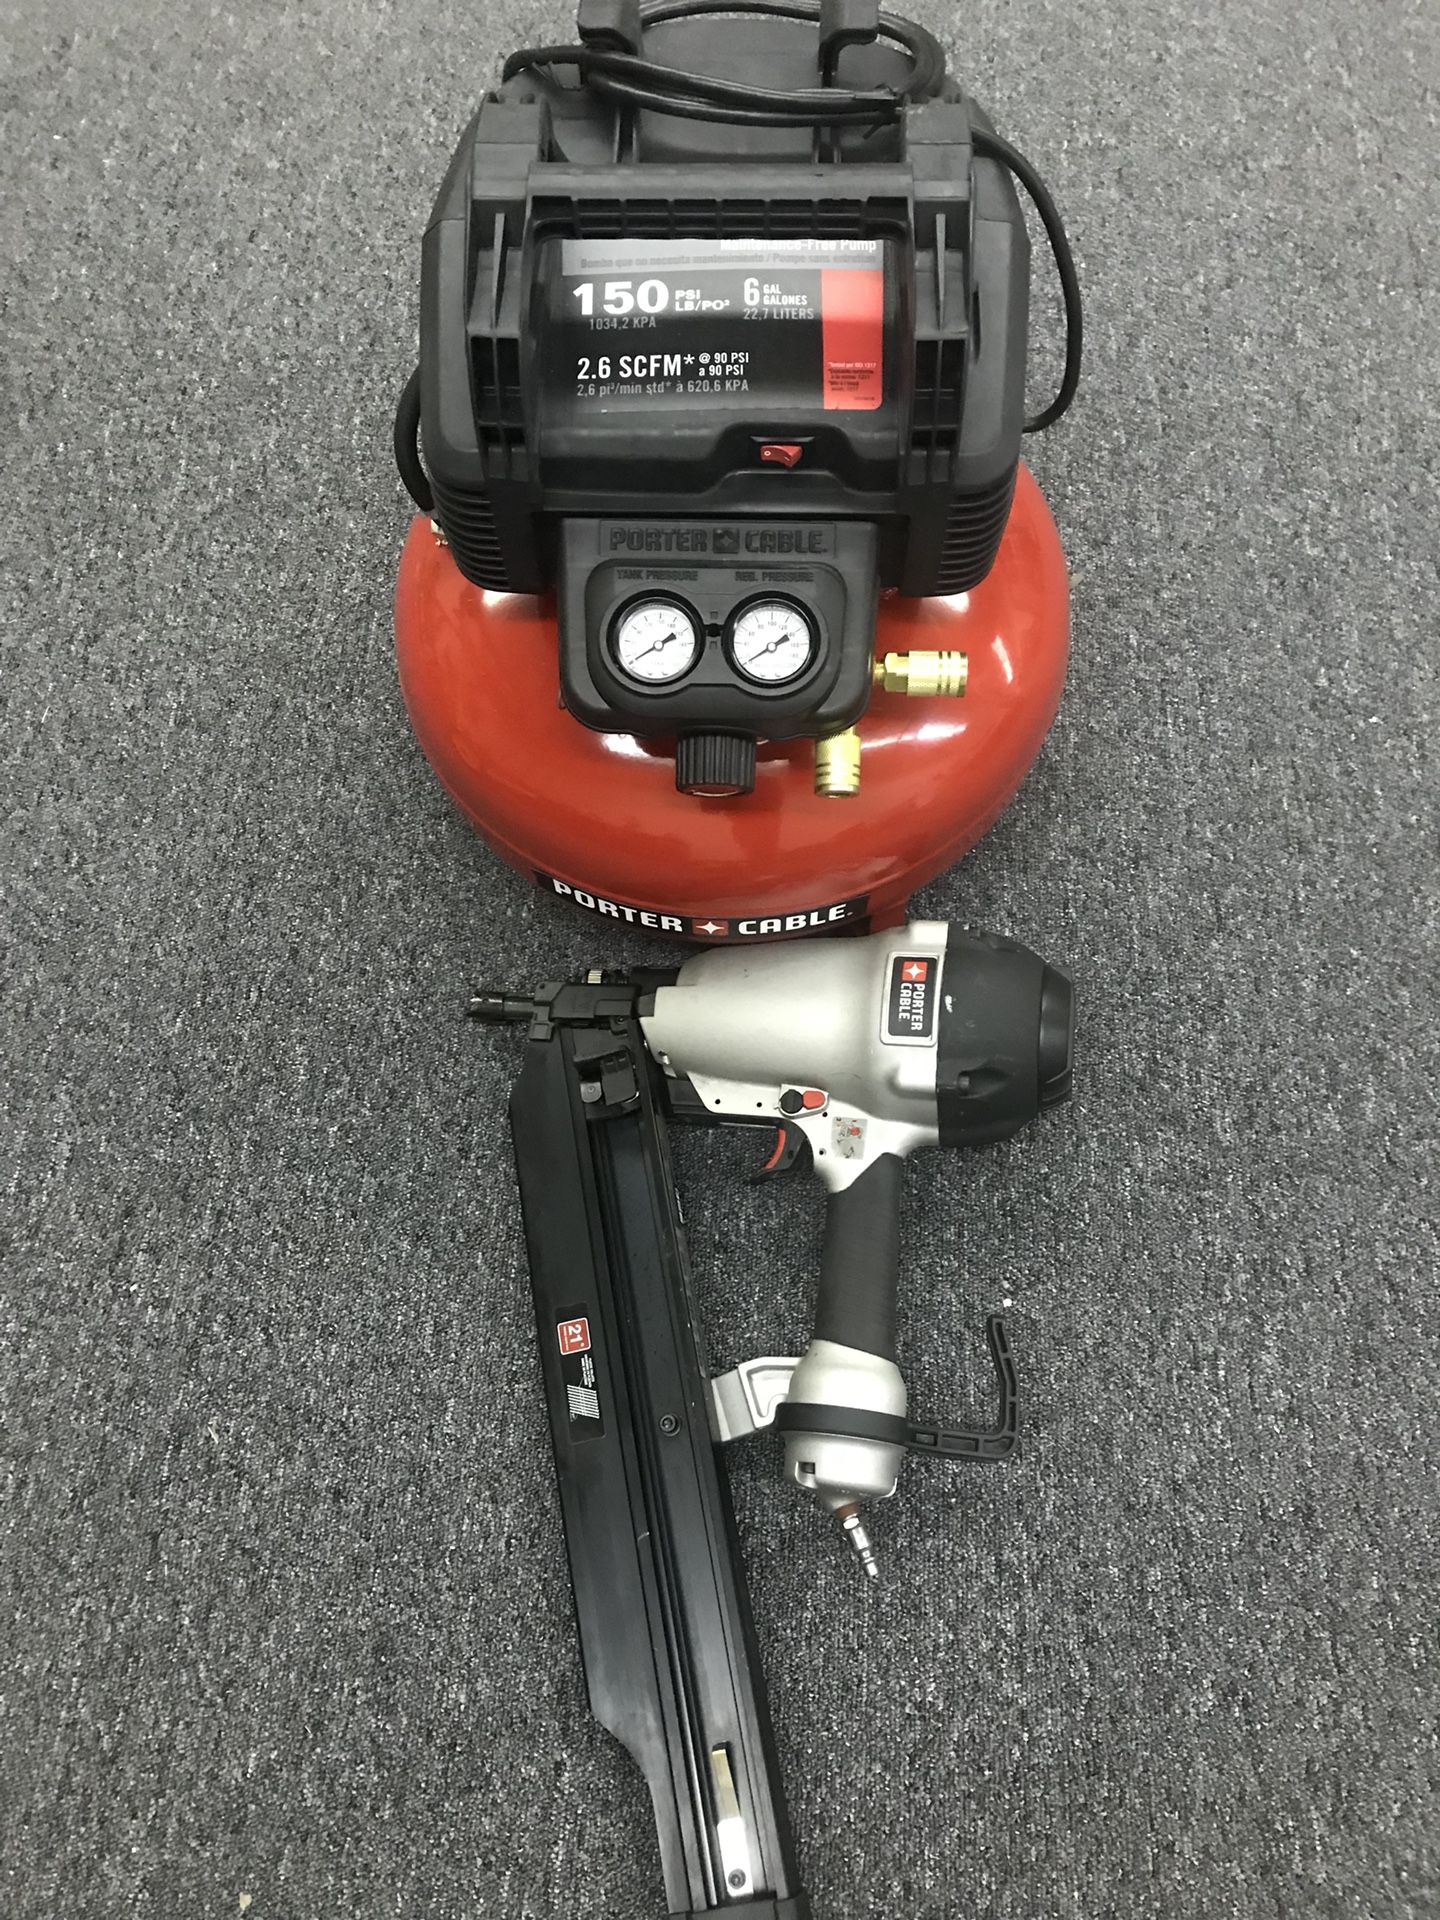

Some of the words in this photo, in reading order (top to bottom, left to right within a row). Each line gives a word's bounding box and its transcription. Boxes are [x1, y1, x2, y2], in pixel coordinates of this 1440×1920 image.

[675, 289, 700, 300] PSI
[744, 277, 760, 306] 6
[762, 283, 782, 294] GAL
[572, 279, 669, 315] 150
[762, 294, 808, 306] GALONES
[743, 307, 769, 321] 22,7
[773, 307, 815, 320] LITERS
[590, 317, 629, 330] 1034,2
[633, 317, 656, 328] KPA
[699, 353, 710, 364] @
[714, 352, 728, 364] 90
[731, 352, 750, 364] PSI
[576, 356, 612, 380] 2.6
[698, 367, 706, 377] a
[708, 364, 722, 376] 90
[725, 364, 744, 376] PSI
[576, 384, 596, 397] 2,6
[676, 380, 684, 392] à
[687, 379, 721, 394] 620,6
[725, 378, 750, 392] KPA
[609, 527, 708, 552] PORTER
[617, 570, 643, 580] TANK
[646, 570, 699, 581] PRESSURE
[762, 572, 814, 582] PRESSURE
[552, 879, 683, 932] PORTER
[910, 983, 926, 1031] PORTER
